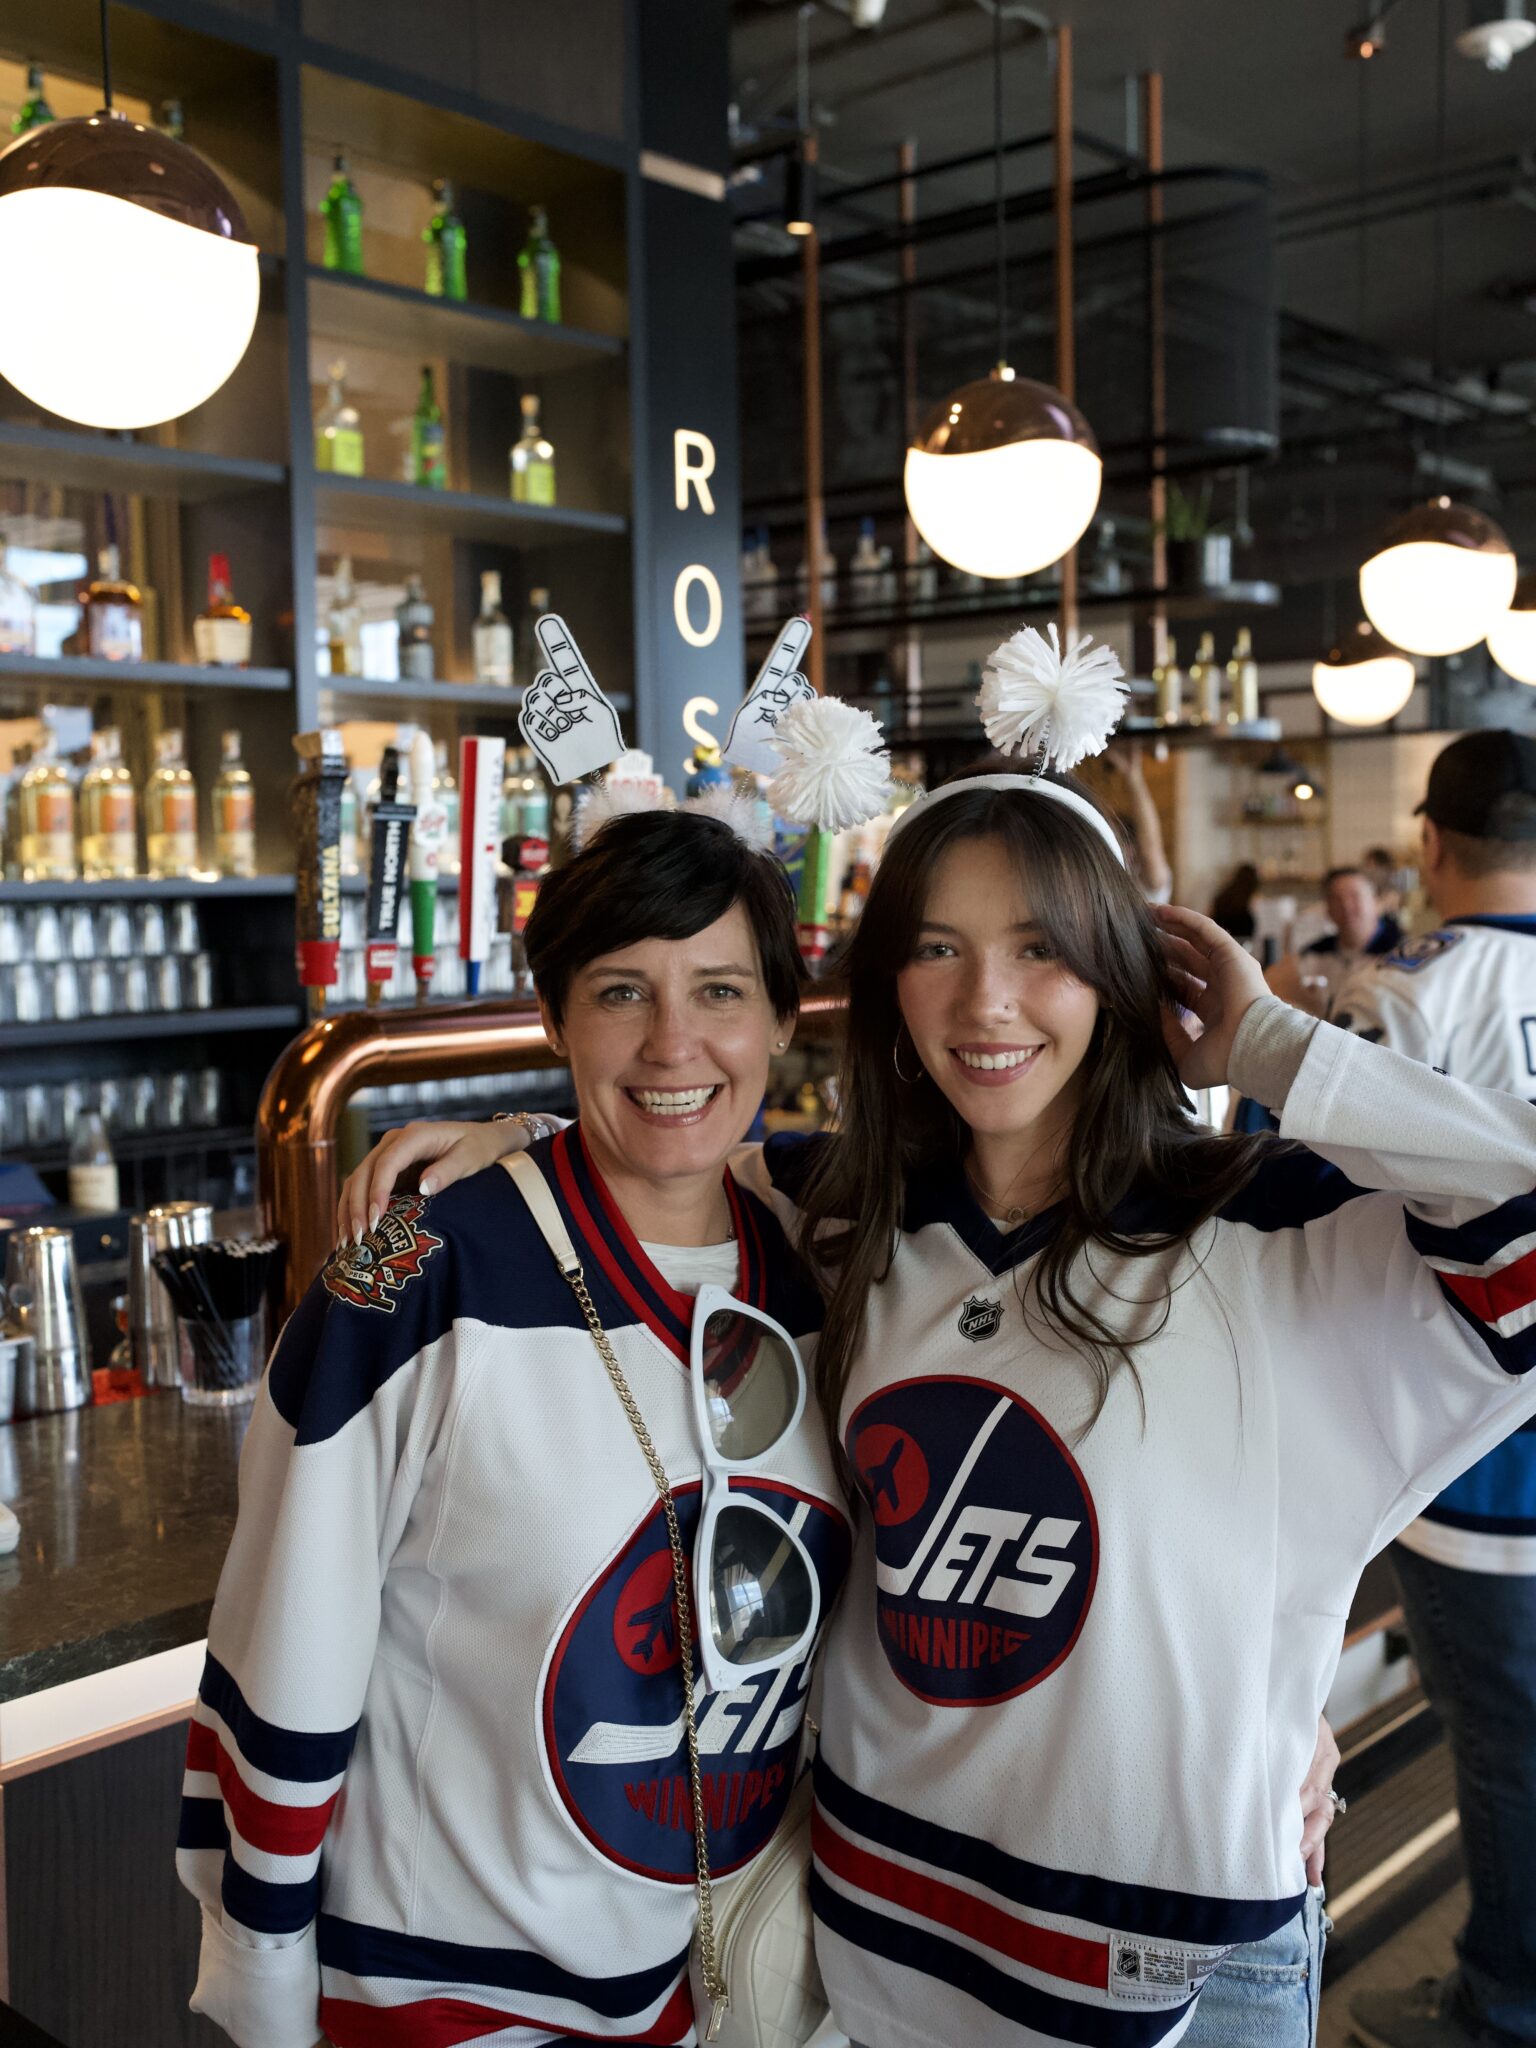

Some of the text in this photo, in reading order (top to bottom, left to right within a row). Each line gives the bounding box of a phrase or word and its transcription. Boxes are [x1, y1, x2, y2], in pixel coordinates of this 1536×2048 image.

[382, 820, 402, 883] NORTH
[321, 844, 340, 939] SULTANA
[378, 885, 397, 931] TRUE
[378, 1215, 409, 1253] ITAGE
[968, 1312, 995, 1331] NHL
